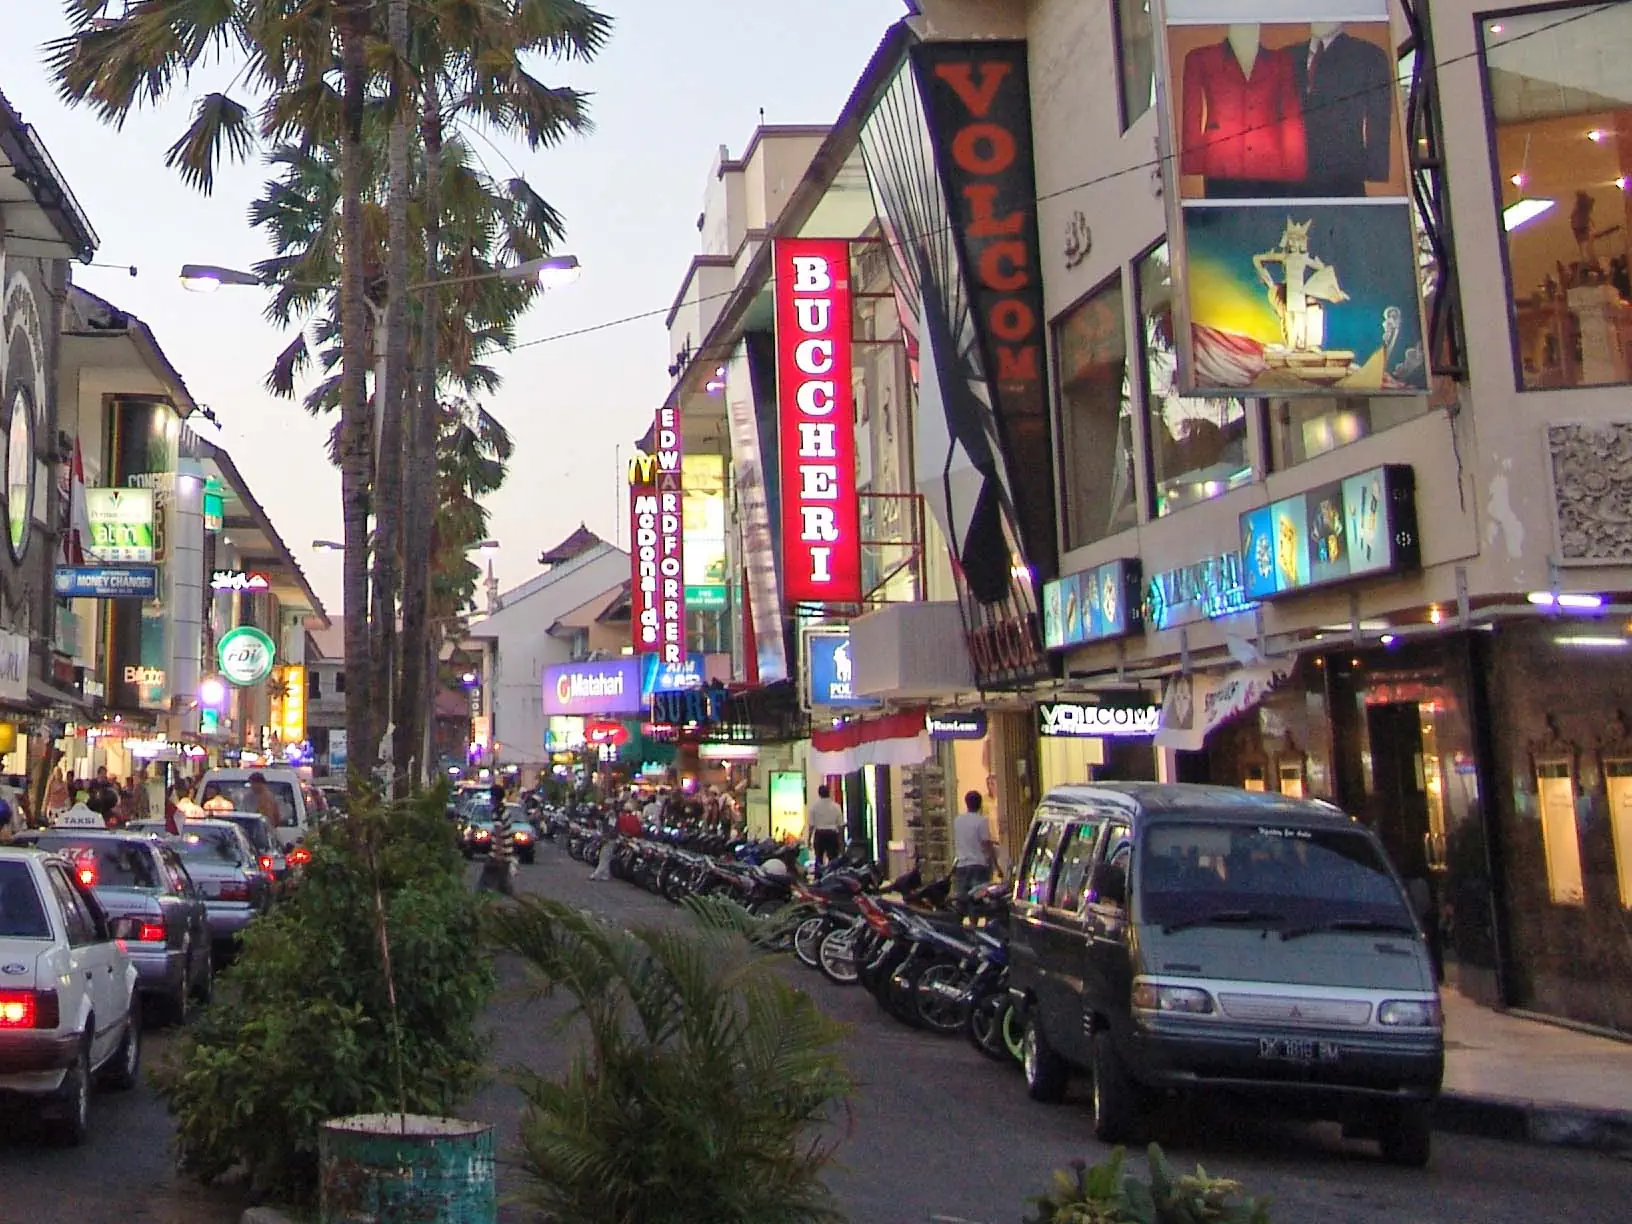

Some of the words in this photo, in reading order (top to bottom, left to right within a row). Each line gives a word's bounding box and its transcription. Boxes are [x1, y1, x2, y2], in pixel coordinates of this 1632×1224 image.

[934, 61, 1039, 380] VOLCOM
[792, 256, 839, 582] BUCCHERI
[76, 574, 110, 588] MONEY
[570, 670, 624, 698] Matahari
[63, 816, 96, 826] TAKSI
